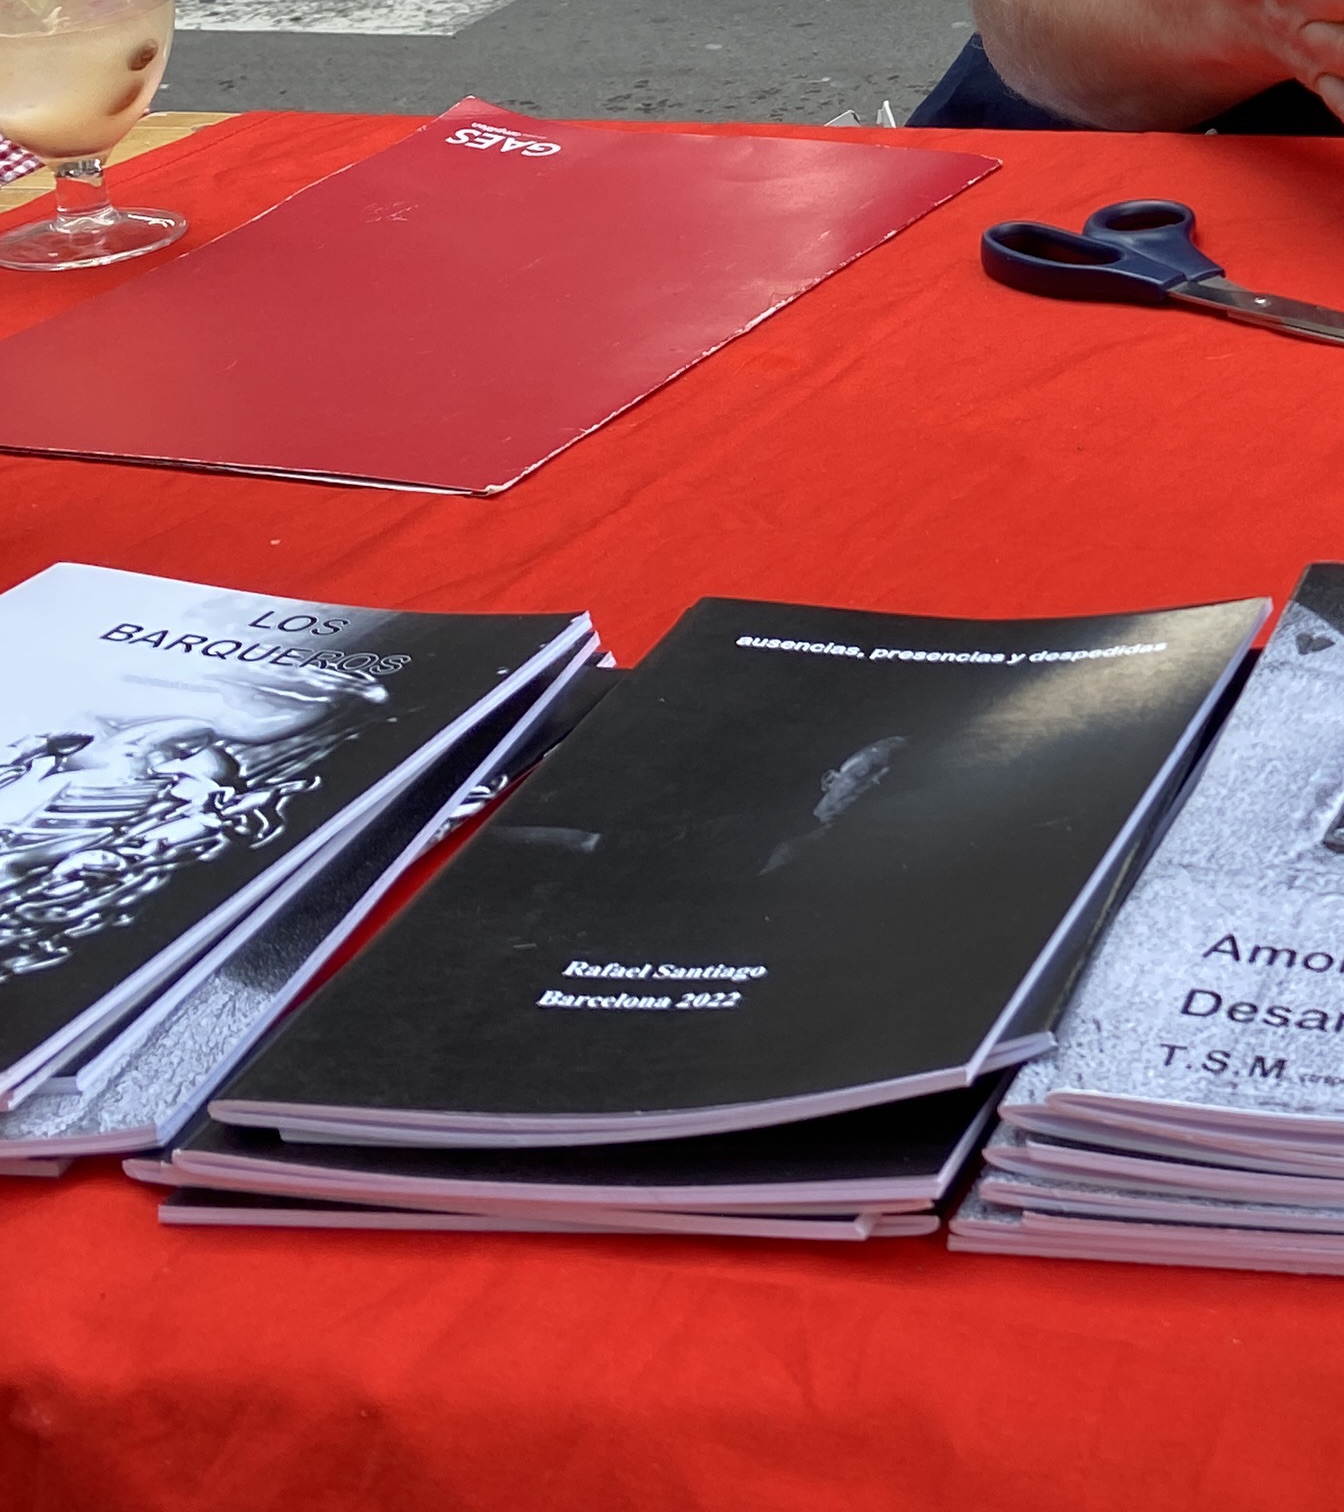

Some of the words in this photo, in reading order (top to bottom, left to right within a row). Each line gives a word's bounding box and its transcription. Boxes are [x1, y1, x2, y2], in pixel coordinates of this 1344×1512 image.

[445, 128, 561, 157] GAES
[249, 610, 353, 637] LOS
[99, 622, 413, 675] BARQUEROS
[736, 636, 864, 658] ausencias,
[869, 648, 1005, 663] presencias
[1007, 653, 1026, 665] y
[1029, 642, 1167, 663] despedidas
[562, 961, 652, 979] Rafael
[653, 963, 767, 982] Santiago
[537, 990, 671, 1009] Barcelona
[676, 992, 741, 1009] 2022
